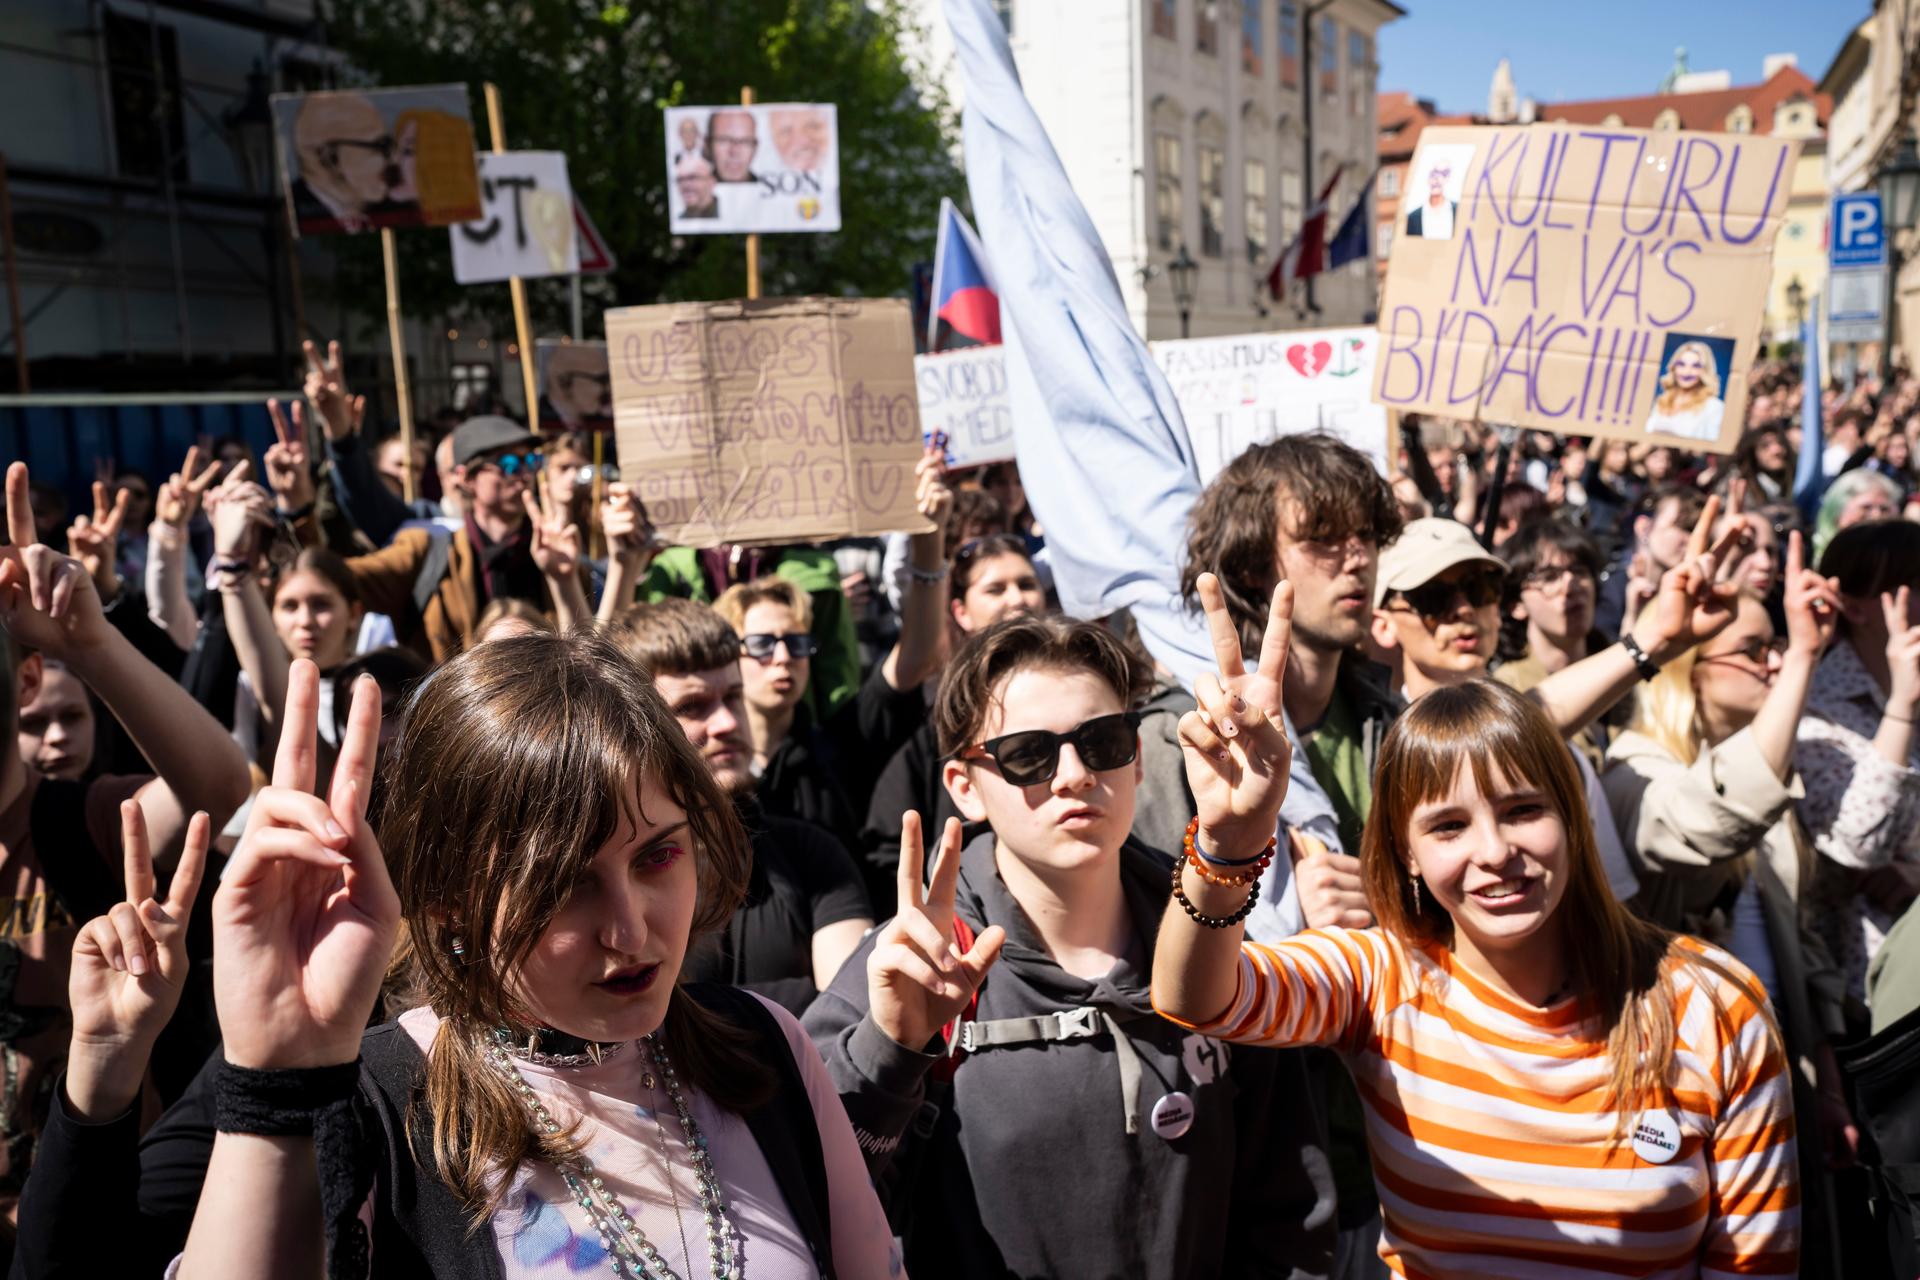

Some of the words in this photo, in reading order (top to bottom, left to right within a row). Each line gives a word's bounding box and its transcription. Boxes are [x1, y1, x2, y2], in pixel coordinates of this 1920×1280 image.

[1470, 132, 1788, 245] KULTURU
[1840, 201, 1878, 248] P
[1450, 227, 1538, 310] NA
[1579, 233, 1702, 328] VÁS
[711, 324, 853, 380] DOST
[1379, 305, 1651, 426] BÍDÁCI!!!
